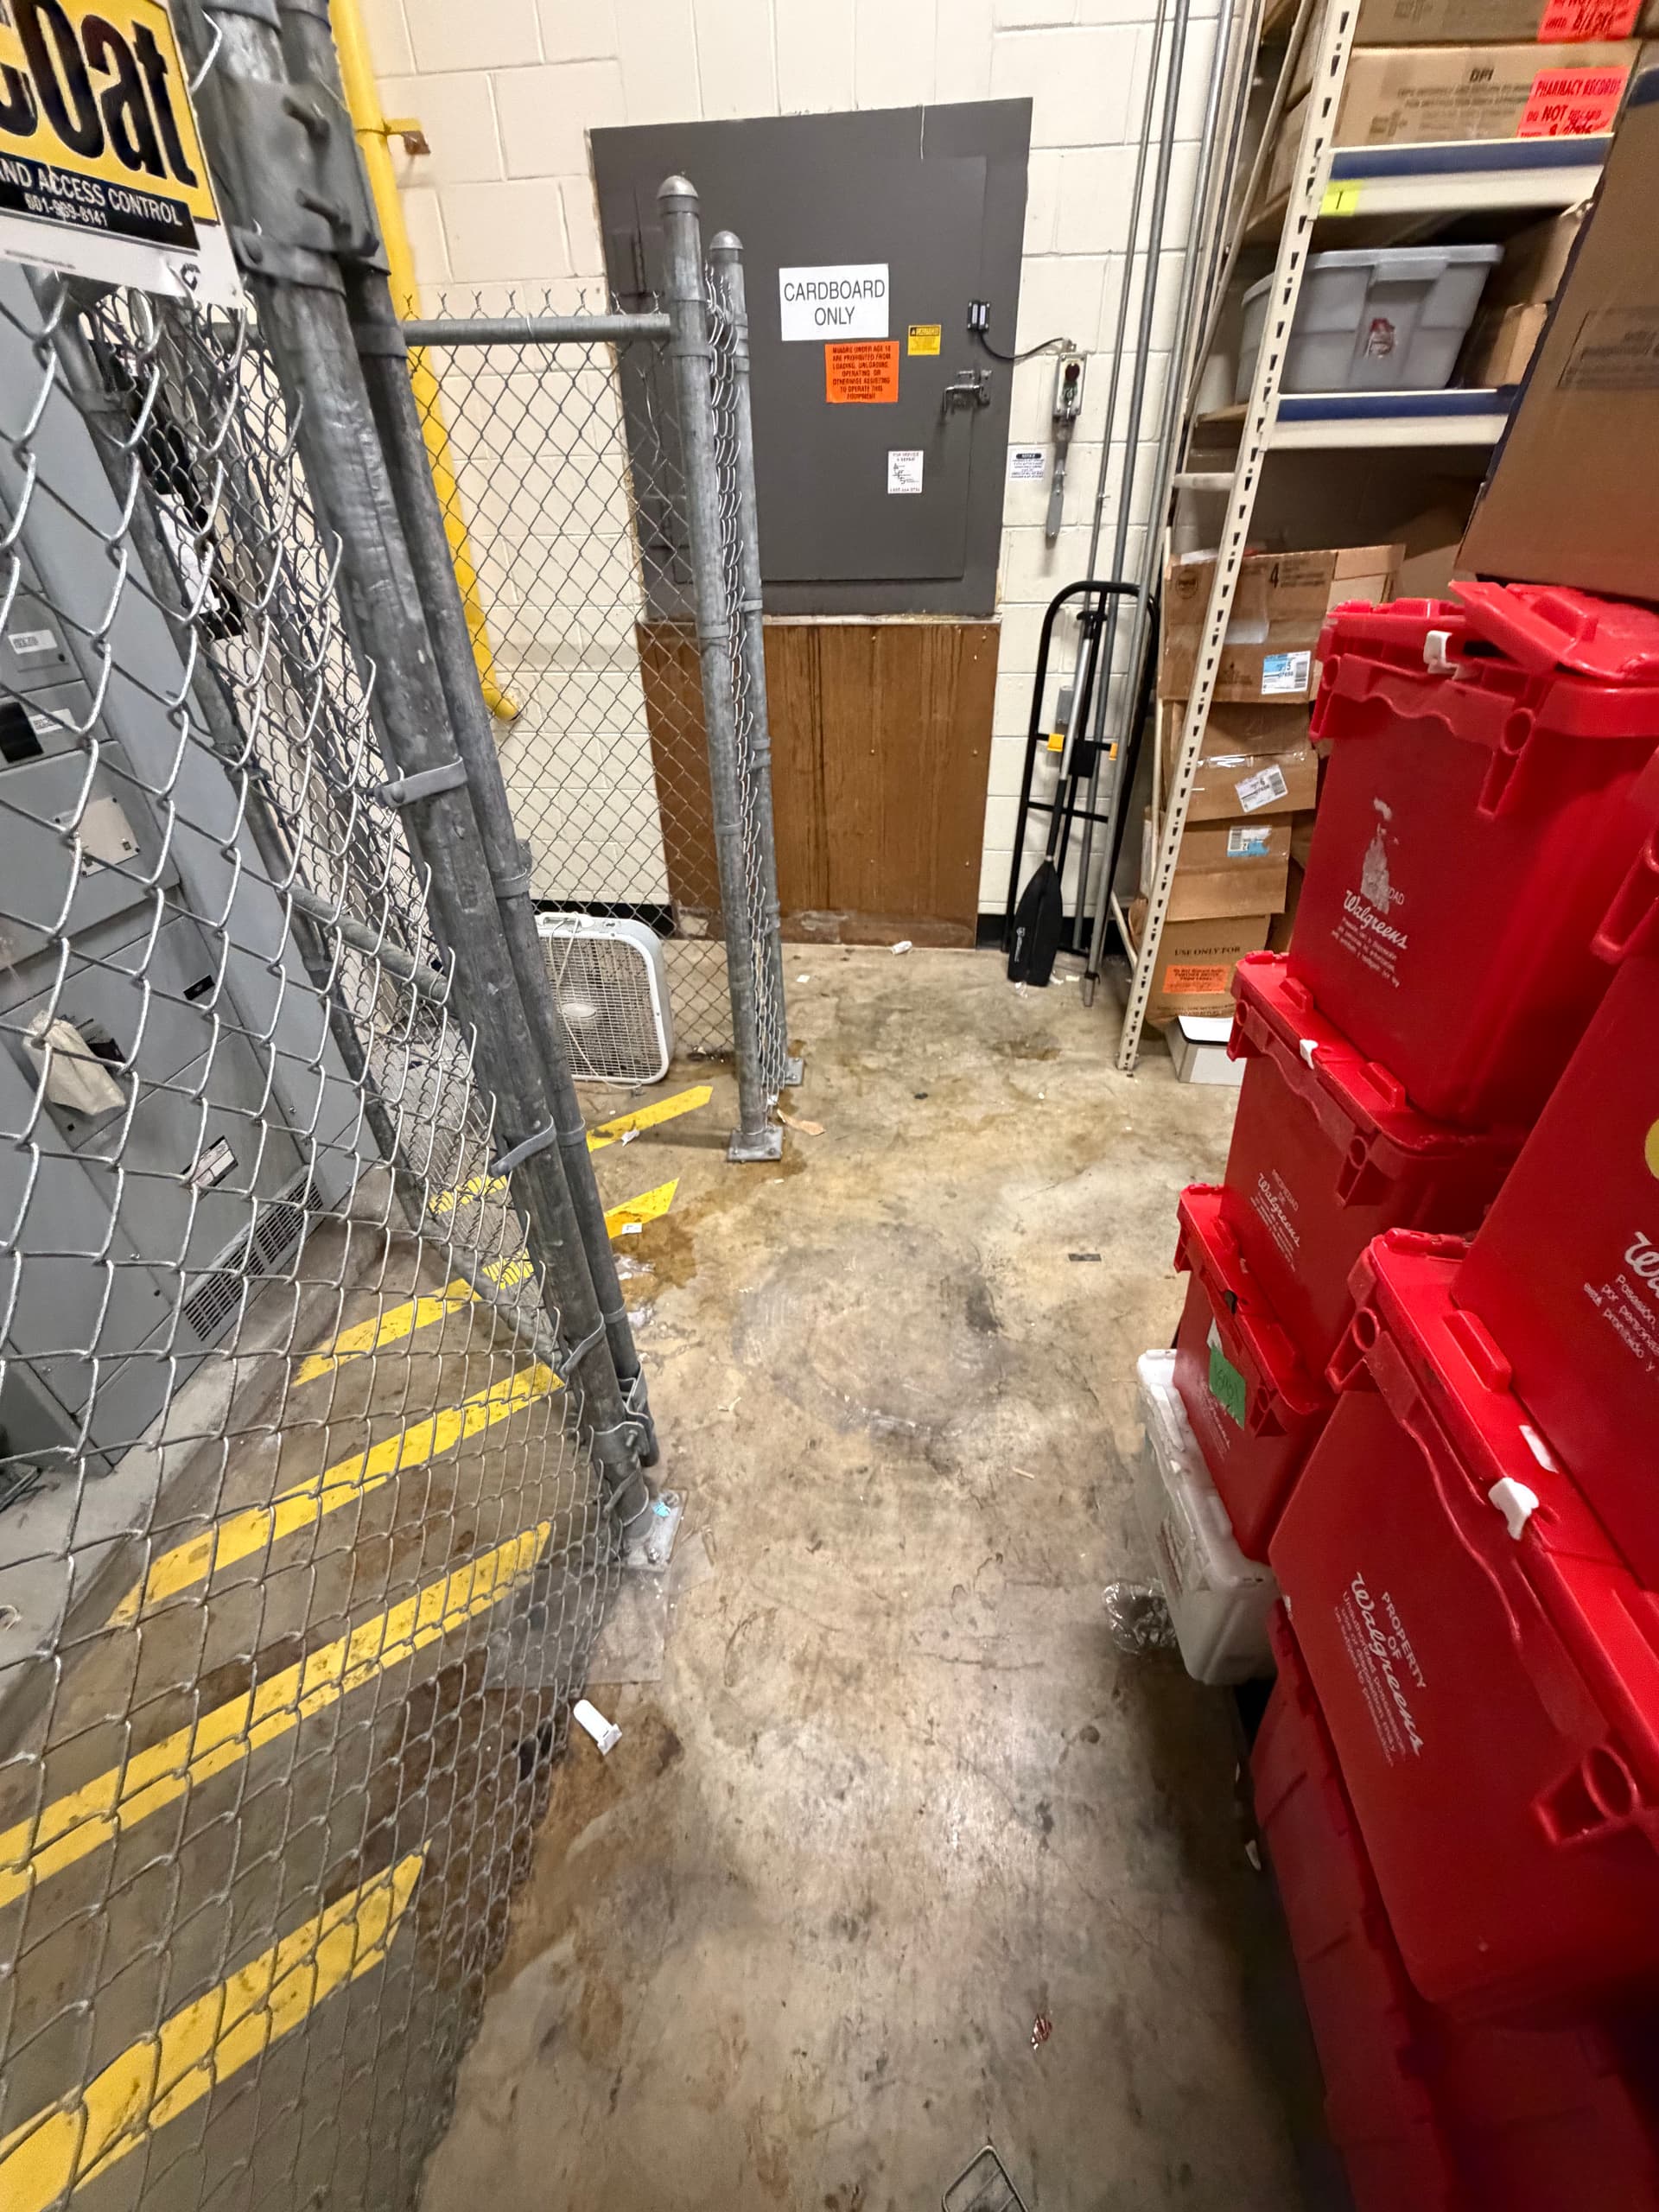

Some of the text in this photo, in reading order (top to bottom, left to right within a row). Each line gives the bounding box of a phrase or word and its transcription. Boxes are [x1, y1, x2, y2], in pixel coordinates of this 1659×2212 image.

[1535, 79, 1583, 98] PHARMACY
[1541, 105, 1568, 122] NOT
[37, 168, 105, 207] ACCESS
[108, 188, 183, 226] CONTROL
[784, 279, 886, 302] CARDBOARD
[814, 306, 855, 326] ONLY
[1268, 563, 1280, 589] 4
[1344, 889, 1408, 950] Walgreens
[1194, 947, 1220, 956] ONLY
[1258, 1172, 1300, 1248] Walgreens
[1382, 1591, 1427, 1688] PROPERTY
[1387, 1635, 1402, 1660] OF
[1351, 1571, 1424, 1757] Walgreens
